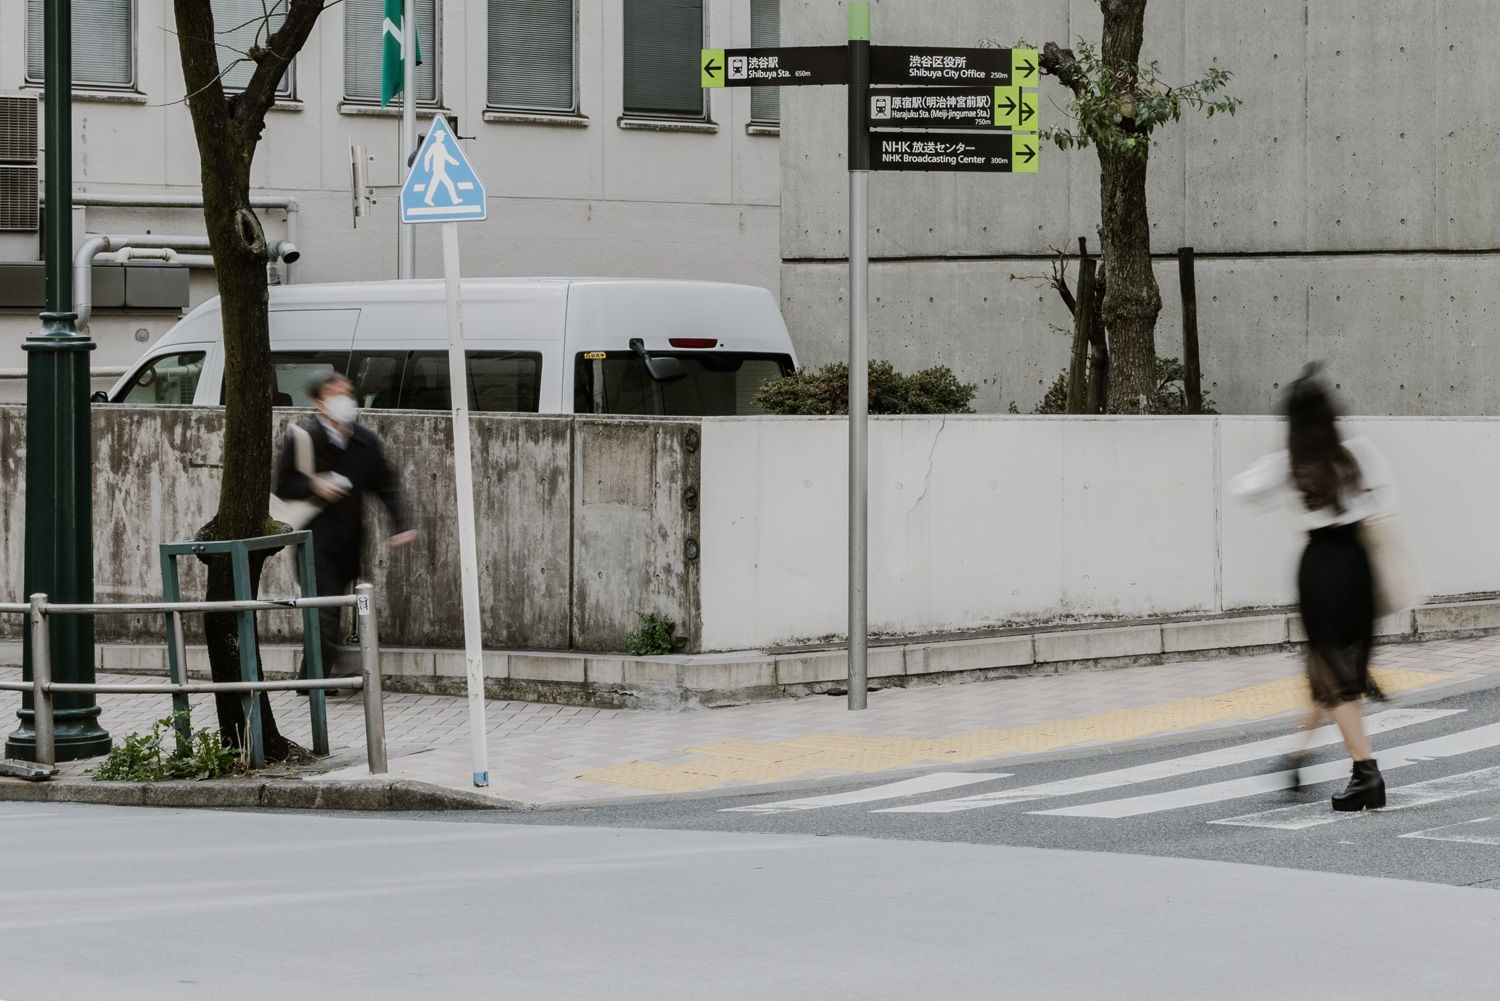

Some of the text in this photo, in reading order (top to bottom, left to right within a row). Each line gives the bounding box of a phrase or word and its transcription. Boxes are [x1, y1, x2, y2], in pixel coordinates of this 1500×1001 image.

[748, 56, 779, 69] 渋谷駅
[909, 55, 967, 69] 渋谷区役所
[748, 70, 777, 80] Shibuya
[777, 69, 791, 78] Sta.
[909, 68, 942, 79] Shibuya
[943, 69, 960, 79] City
[960, 69, 986, 79] Office
[891, 110, 919, 120] Harajuku
[919, 110, 930, 118] Sta.
[882, 140, 976, 154] NHK 放送センター
[882, 153, 902, 162] NHK
[903, 154, 957, 165] Broadcasting
[958, 155, 986, 164] Center
